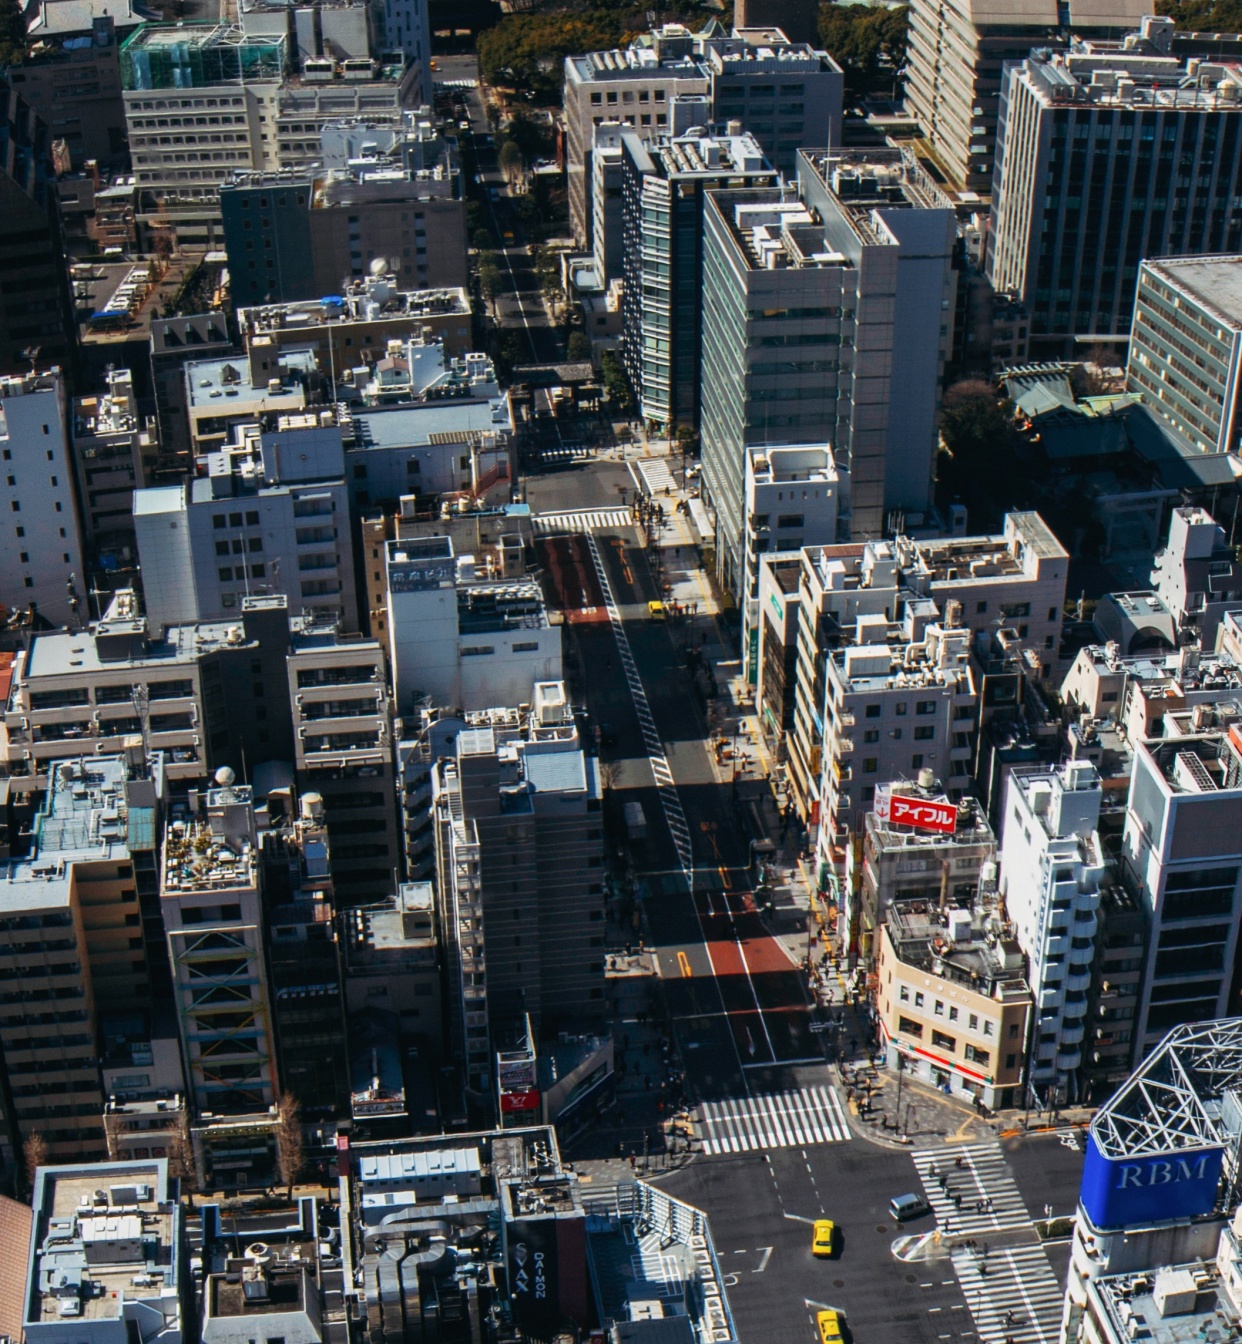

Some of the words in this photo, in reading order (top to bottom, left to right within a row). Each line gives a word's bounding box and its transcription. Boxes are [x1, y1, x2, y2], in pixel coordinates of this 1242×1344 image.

[894, 802, 953, 825] アイフル
[1117, 1155, 1210, 1189] RBM
[534, 1252, 547, 1299] DAIMON
